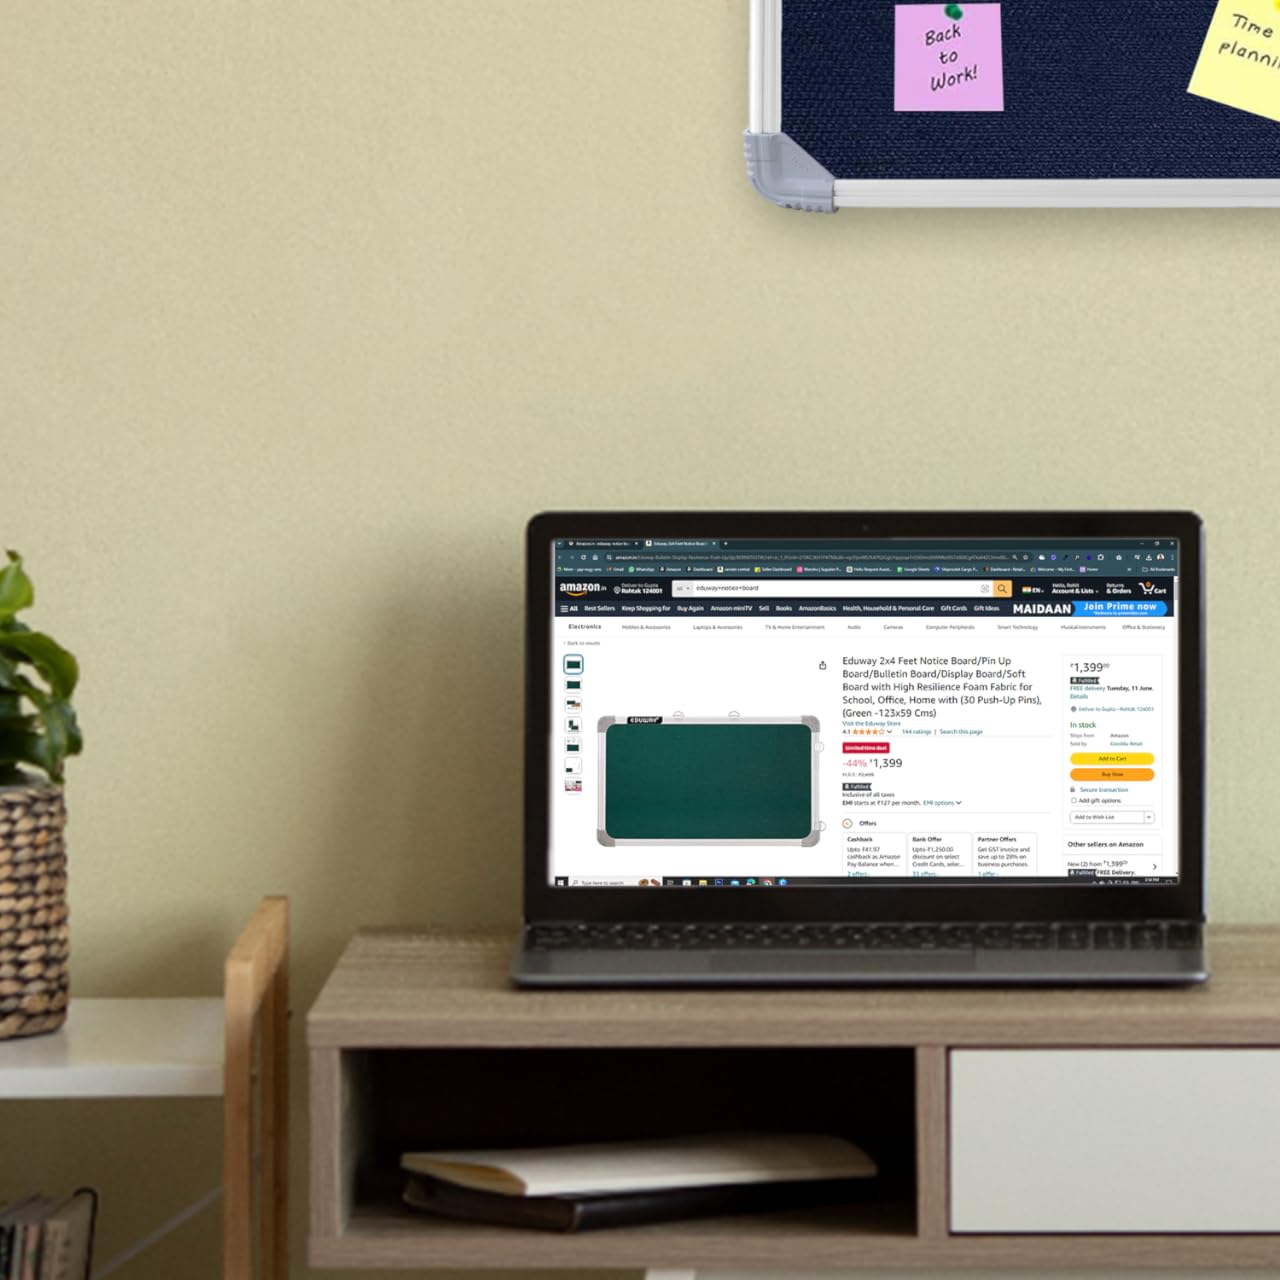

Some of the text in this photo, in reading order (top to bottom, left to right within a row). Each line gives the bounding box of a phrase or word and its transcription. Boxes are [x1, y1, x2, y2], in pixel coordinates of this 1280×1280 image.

[1232, 13, 1274, 38] Time
[925, 24, 961, 46] Back
[939, 51, 958, 64] to
[930, 64, 978, 92] Work!
[560, 583, 607, 593] amazon.in
[1013, 604, 1072, 613] MAIDAAN
[1084, 602, 1104, 610] Join
[1106, 602, 1135, 610] Prime
[842, 657, 1012, 666] Eduway 2x4 Feet Notice Board/Pin Up
[842, 670, 1026, 679] Board/Bulletin Board/Display Board/Soft
[842, 683, 869, 691] Board
[893, 683, 915, 693] High
[916, 683, 961, 691] Resilience
[963, 683, 988, 691] Foam
[1019, 683, 1033, 691] for
[842, 696, 1042, 705] School, Office, Home with (30 Push-Up Pins),
[842, 709, 937, 718] (Green -123x59 Cms)
